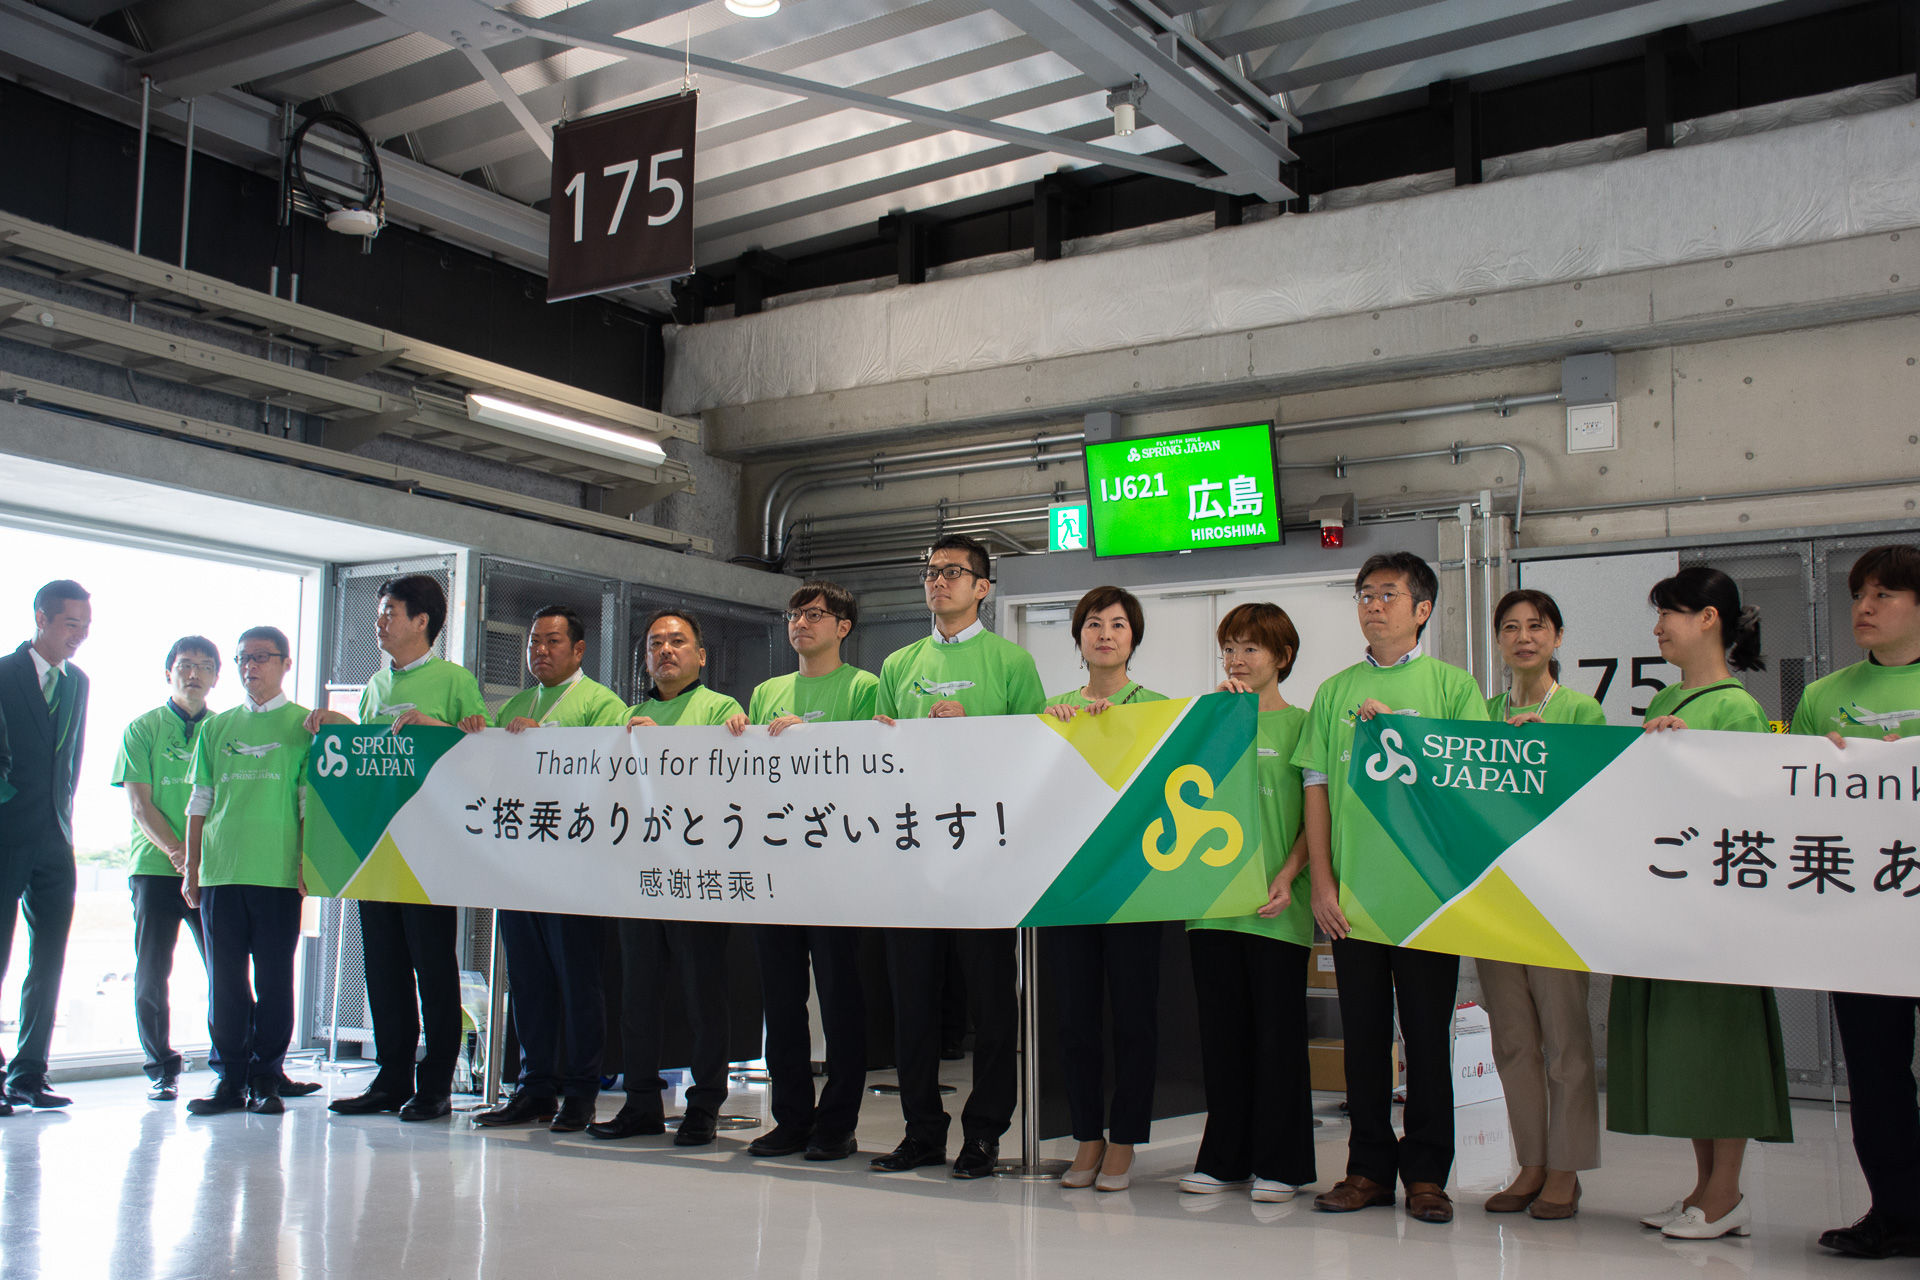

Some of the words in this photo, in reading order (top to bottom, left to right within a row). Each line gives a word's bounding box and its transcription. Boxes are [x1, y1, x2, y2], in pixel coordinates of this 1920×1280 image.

[564, 148, 684, 243] 175
[1141, 445, 1182, 459] SPRING
[1184, 440, 1221, 454] JAPAN
[1101, 472, 1169, 502] IJ621
[1188, 475, 1264, 521] 広島
[1191, 523, 1267, 542] HIROSHIMA
[1578, 656, 1667, 717] 75
[351, 736, 415, 756] SPRING
[1422, 734, 1549, 765] SPRING
[356, 757, 416, 777] JAPAN
[536, 749, 601, 775] Thank
[608, 756, 649, 782] you
[660, 749, 699, 776] for
[708, 748, 781, 784] flying
[791, 746, 849, 775] with
[862, 752, 904, 774] us.
[1432, 763, 1548, 795] JAPAN
[465, 796, 1007, 850] ご搭乗ありがとうございます!
[1648, 826, 1920, 898] ご搭乗あ
[639, 867, 774, 902] 感谢搭乘!
